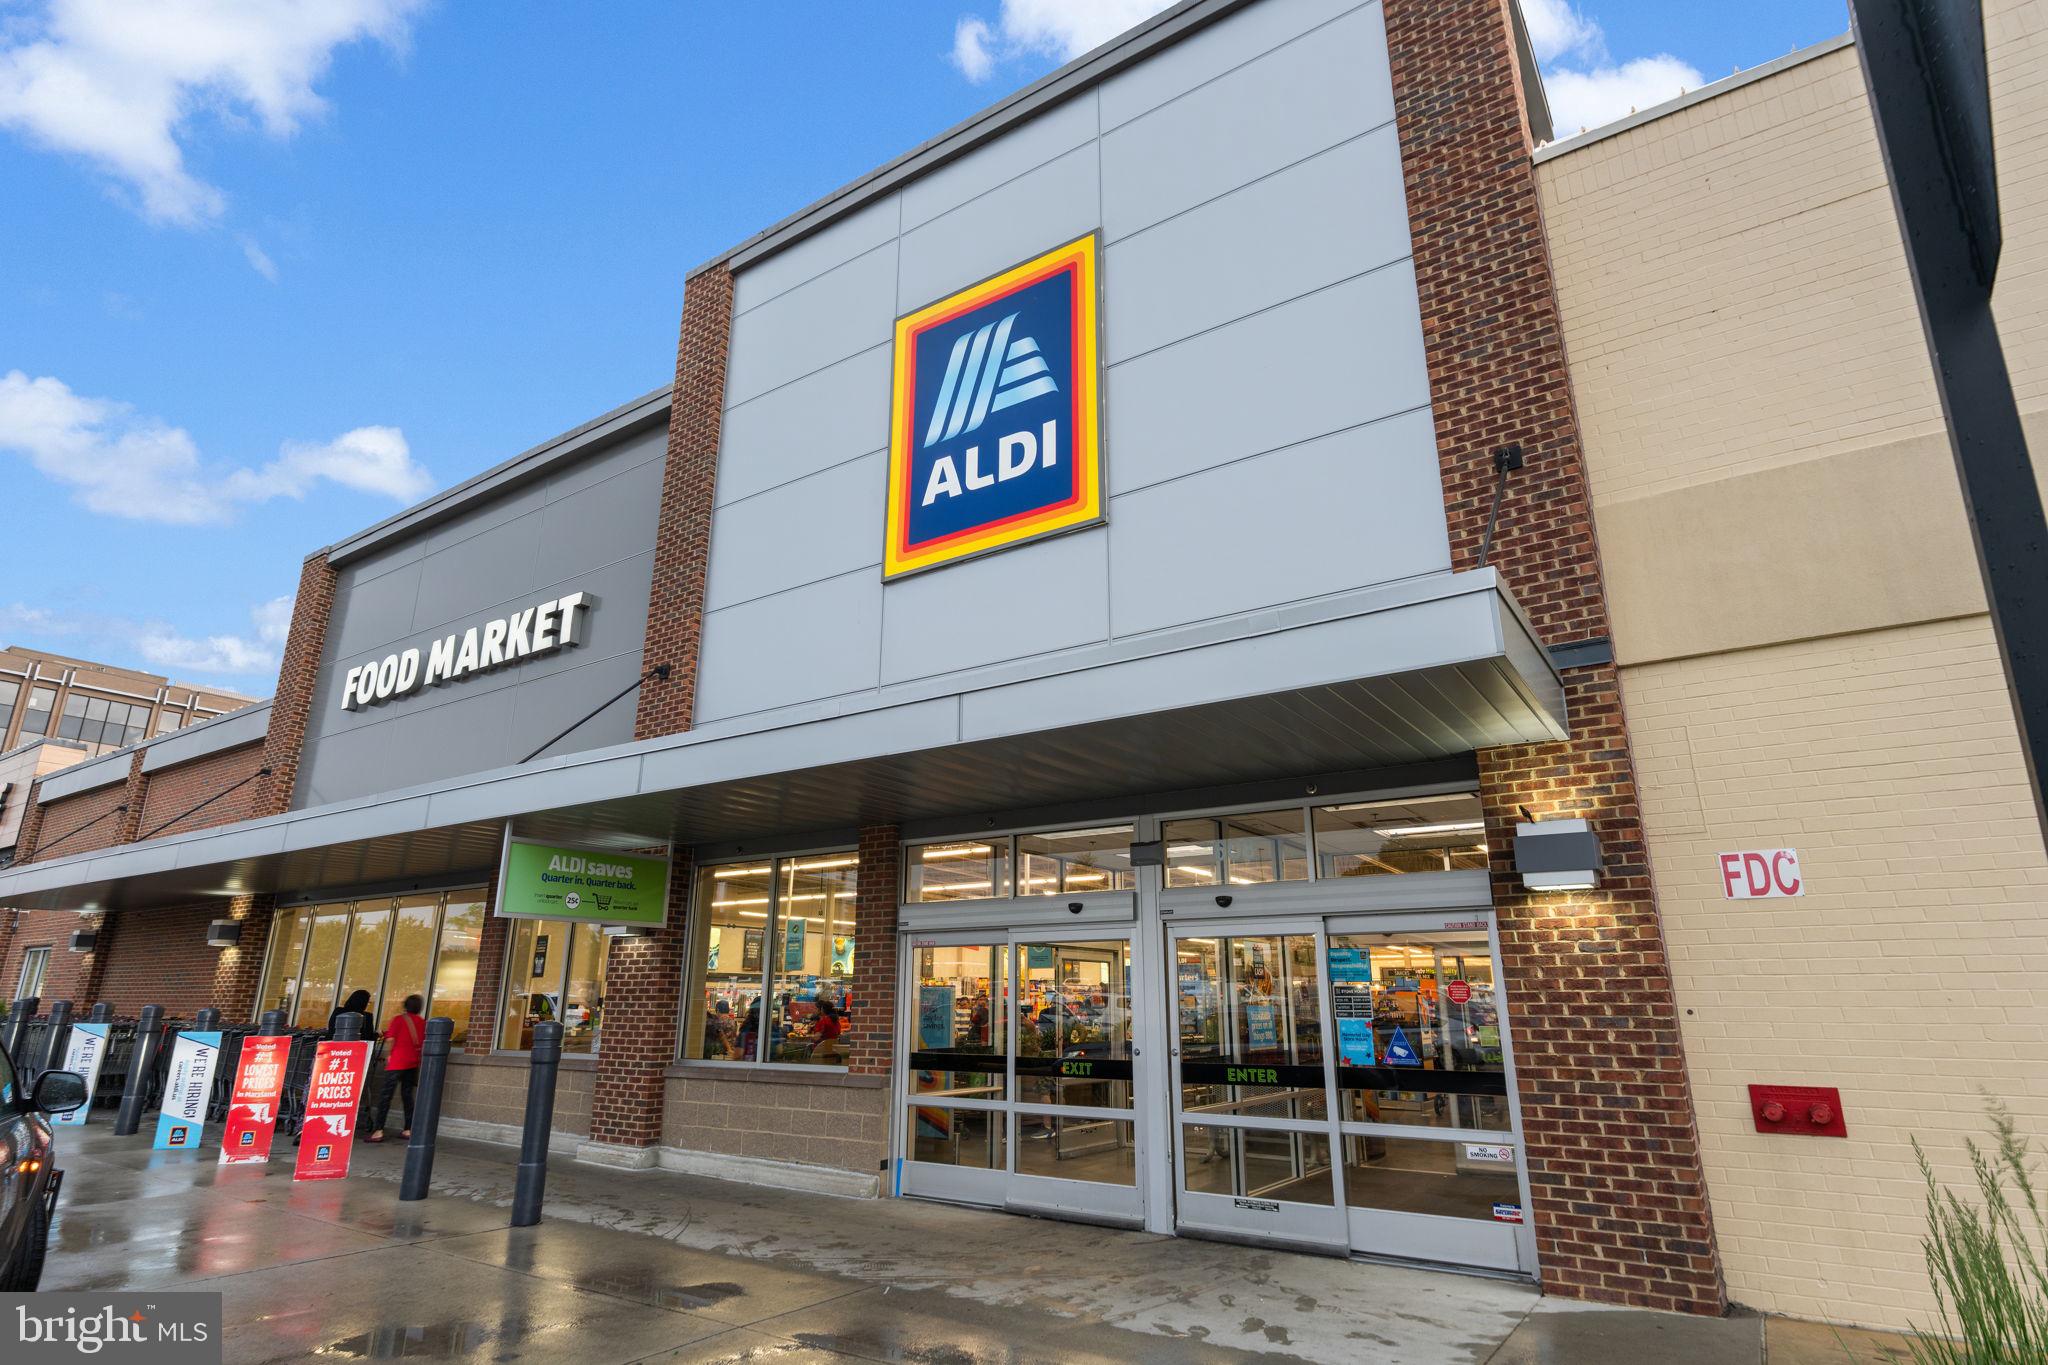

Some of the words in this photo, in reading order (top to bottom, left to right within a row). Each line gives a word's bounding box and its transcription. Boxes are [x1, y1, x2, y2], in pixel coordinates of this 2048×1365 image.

[922, 419, 1057, 507] ALDI
[340, 648, 420, 710] FOOD
[424, 591, 584, 686] MARKET
[548, 854, 586, 874] ALDI
[587, 862, 633, 879] saves
[1720, 850, 1800, 897] FDC
[541, 872, 573, 884] Quarter
[574, 875, 585, 886] in.
[586, 878, 617, 889] Quarter
[617, 880, 637, 891] back.
[566, 897, 579, 905] 25¢
[191, 1047, 210, 1078] WE'RE
[244, 1063, 279, 1076] LOWEST
[1062, 1061, 1093, 1076] EXIT
[242, 1076, 276, 1089] PRICES
[318, 1071, 355, 1085] LOWEST
[1227, 1067, 1278, 1083] ENTER
[183, 1082, 203, 1118] HIRING!
[244, 1090, 277, 1098] Maryland
[316, 1086, 352, 1100] PRICES
[311, 1101, 319, 1109] in
[319, 1100, 353, 1109] Maryland
